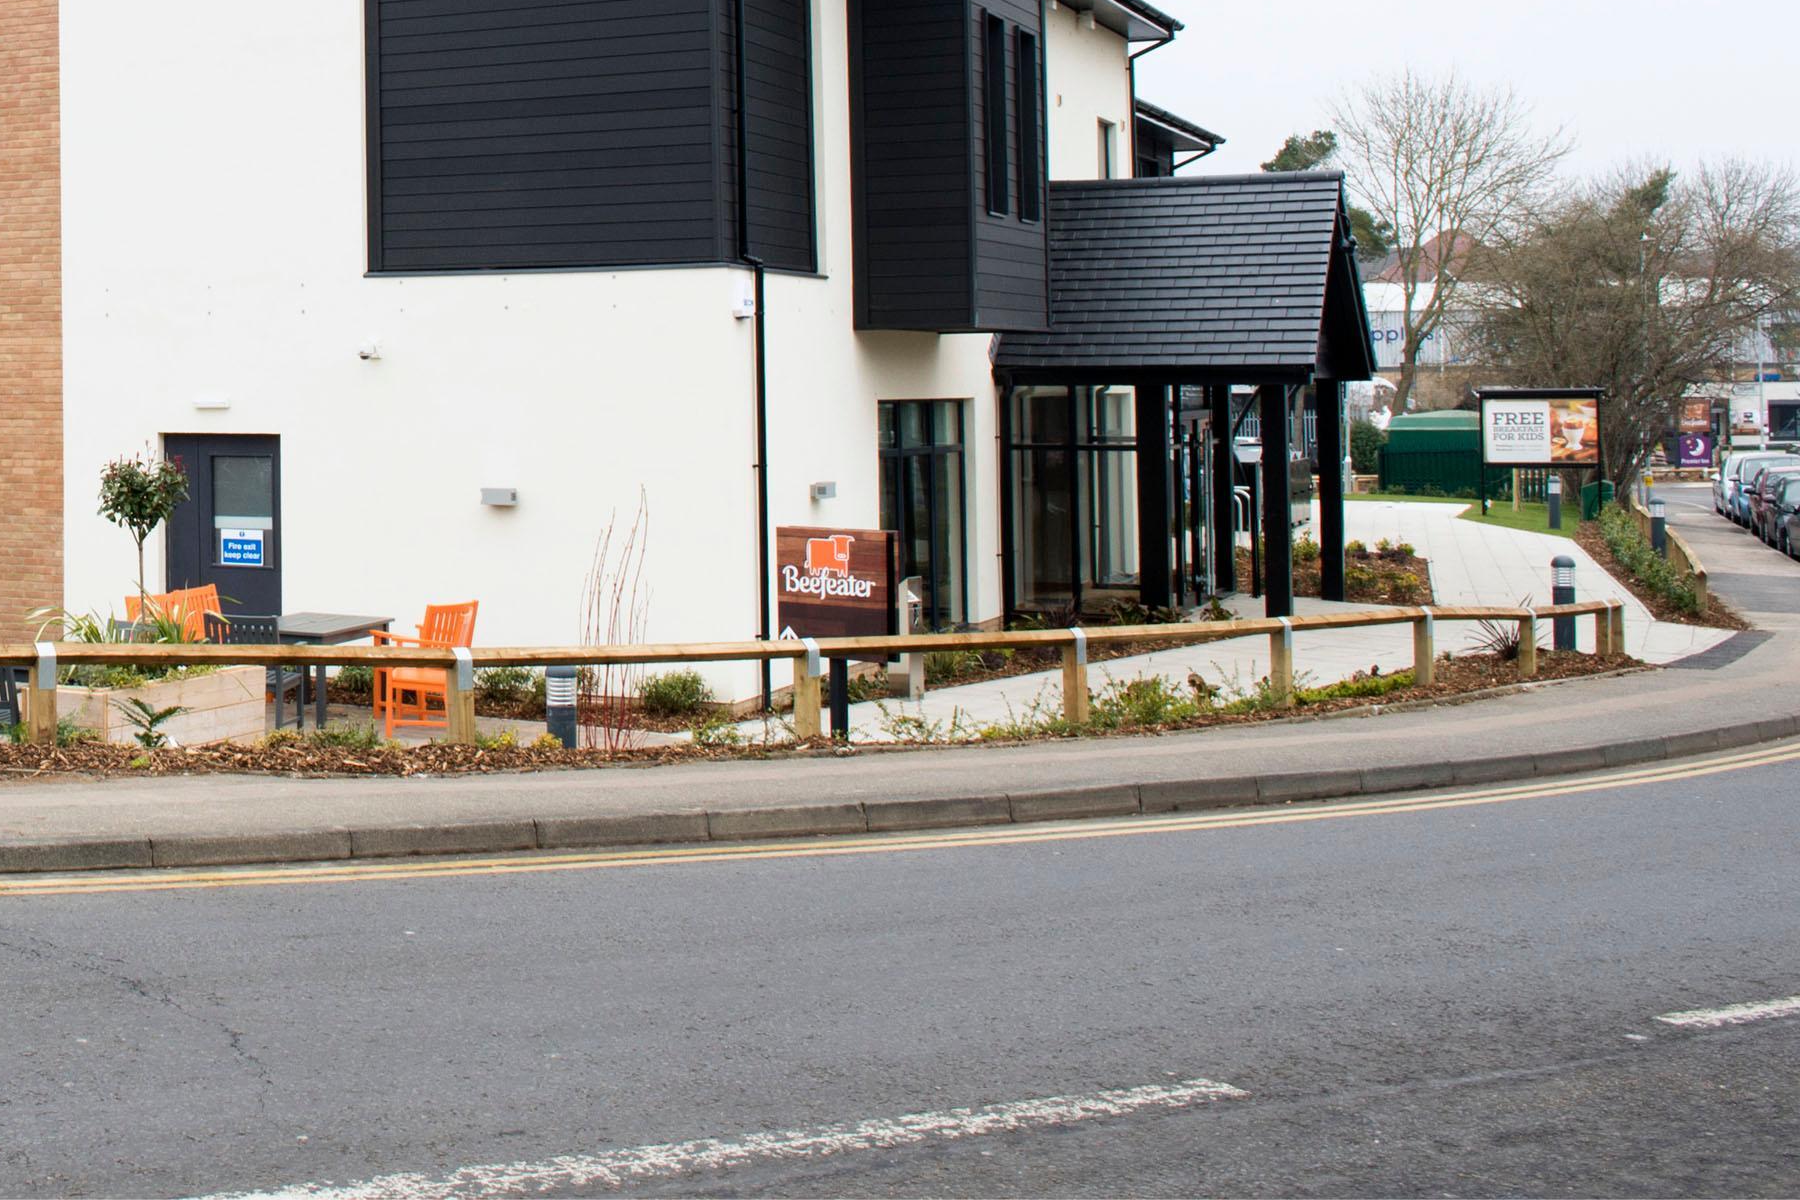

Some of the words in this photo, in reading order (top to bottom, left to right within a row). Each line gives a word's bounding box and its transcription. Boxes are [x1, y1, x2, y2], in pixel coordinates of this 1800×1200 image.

[1492, 412, 1544, 425] FREE
[1493, 433, 1515, 441] FOR
[1517, 433, 1544, 441] KIDS
[228, 542, 242, 550] Fire
[243, 542, 256, 550] exit
[224, 551, 242, 560] keep
[242, 551, 260, 560] clear
[782, 564, 876, 600] Beefeater
